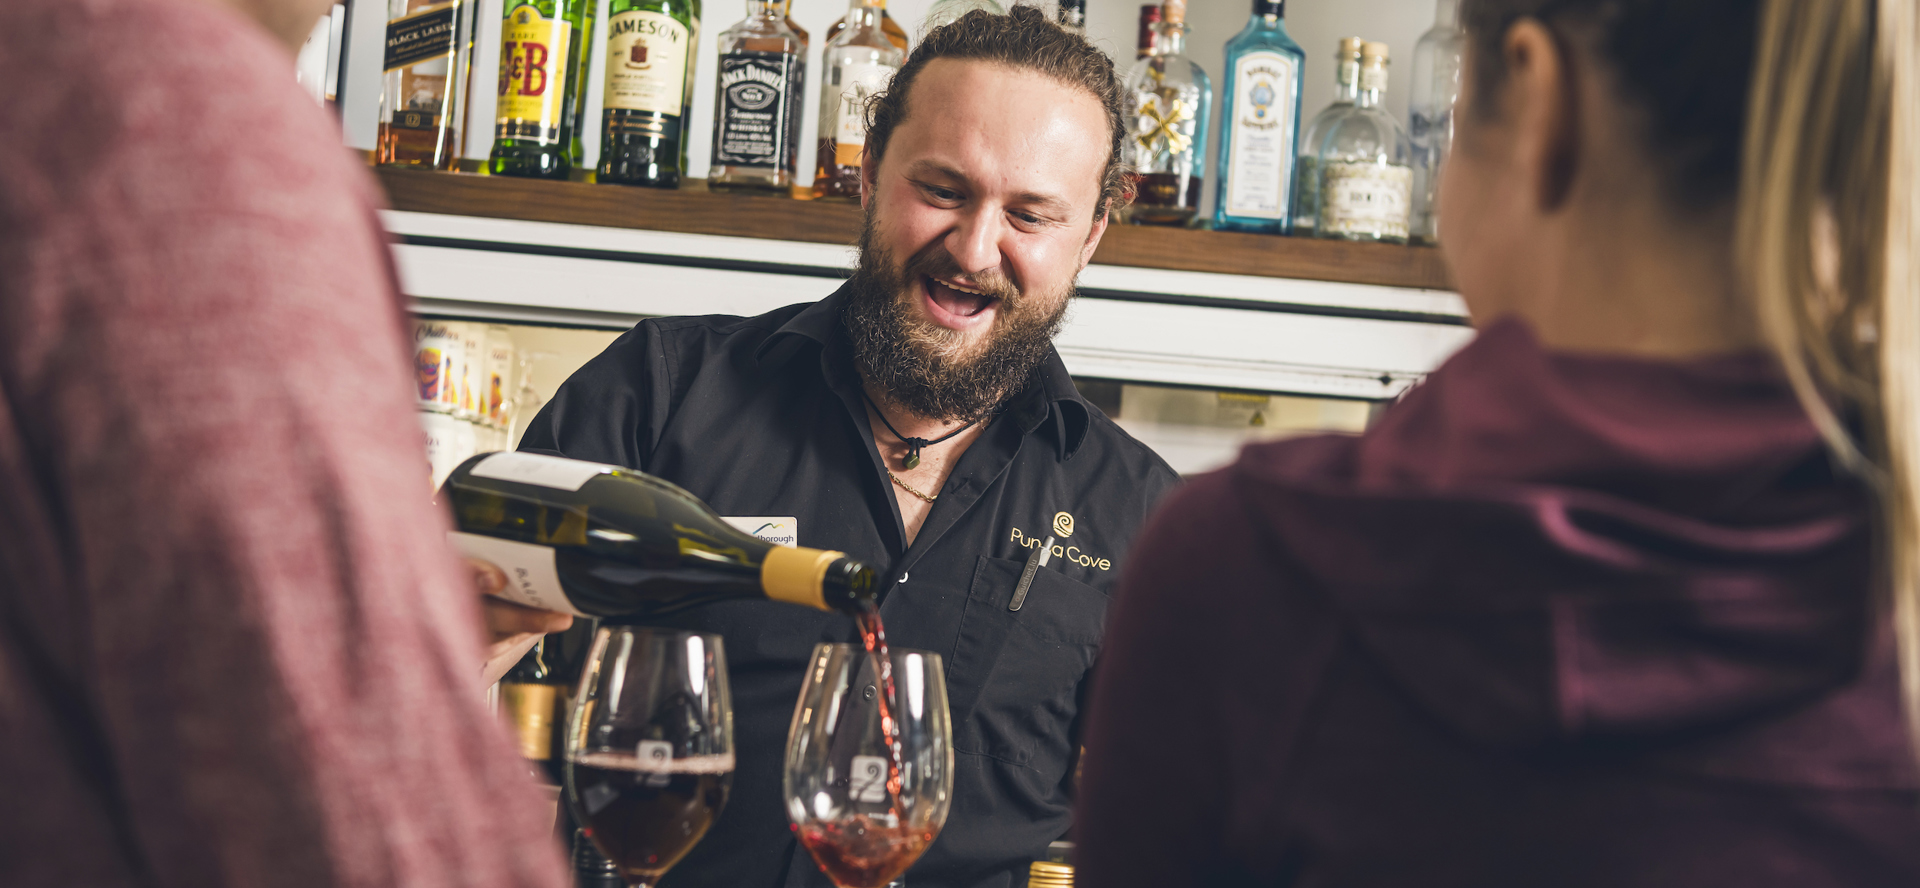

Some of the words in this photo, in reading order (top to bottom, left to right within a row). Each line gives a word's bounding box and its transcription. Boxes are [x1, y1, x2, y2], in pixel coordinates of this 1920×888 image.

[388, 31, 420, 47] BLACK
[608, 19, 679, 43] JAMESON
[498, 41, 548, 96] J&B
[721, 68, 746, 89] JACK
[757, 535, 794, 545] lborough
[1010, 527, 1064, 558] Puna
[1066, 546, 1111, 571] Cove
[1017, 559, 1037, 596] Guichet.lu
